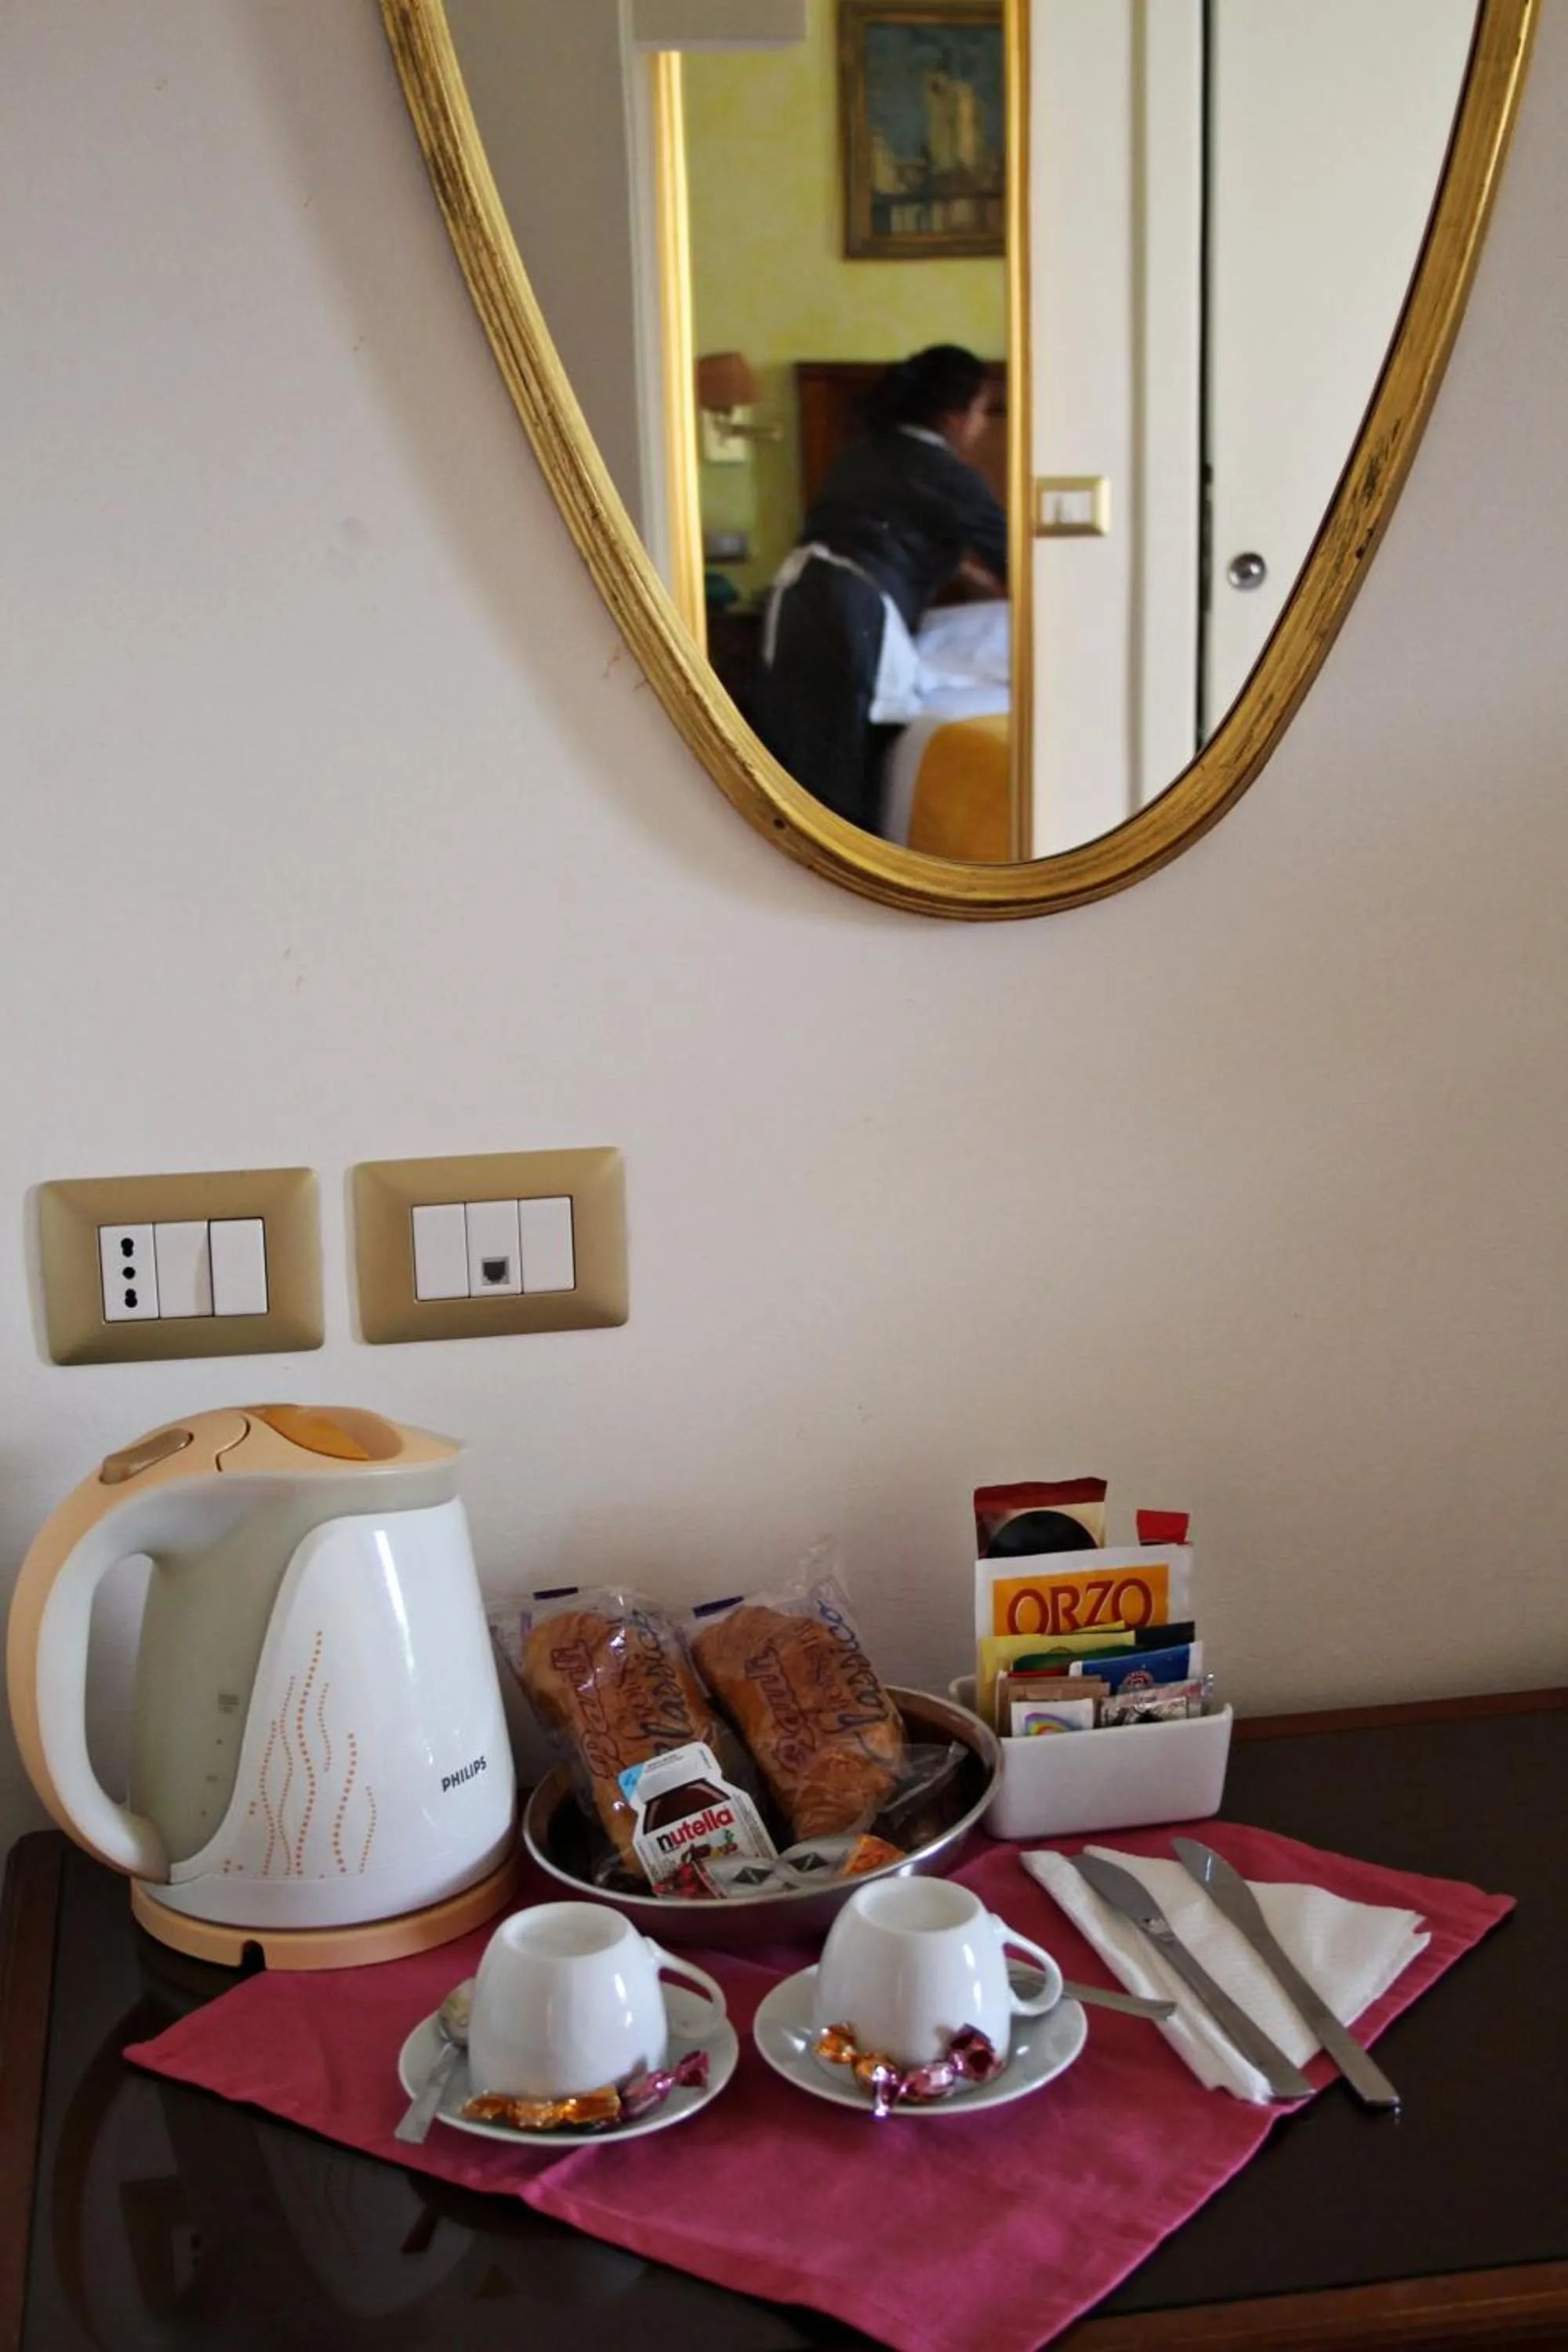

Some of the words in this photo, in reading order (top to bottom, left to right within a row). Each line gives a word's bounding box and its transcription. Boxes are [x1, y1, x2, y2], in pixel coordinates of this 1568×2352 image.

[1007, 1577, 1152, 1635] ORZO
[632, 1610, 694, 1757] lassico
[441, 1755, 488, 1793] PHILIPS
[656, 1807, 735, 1853] nutella
